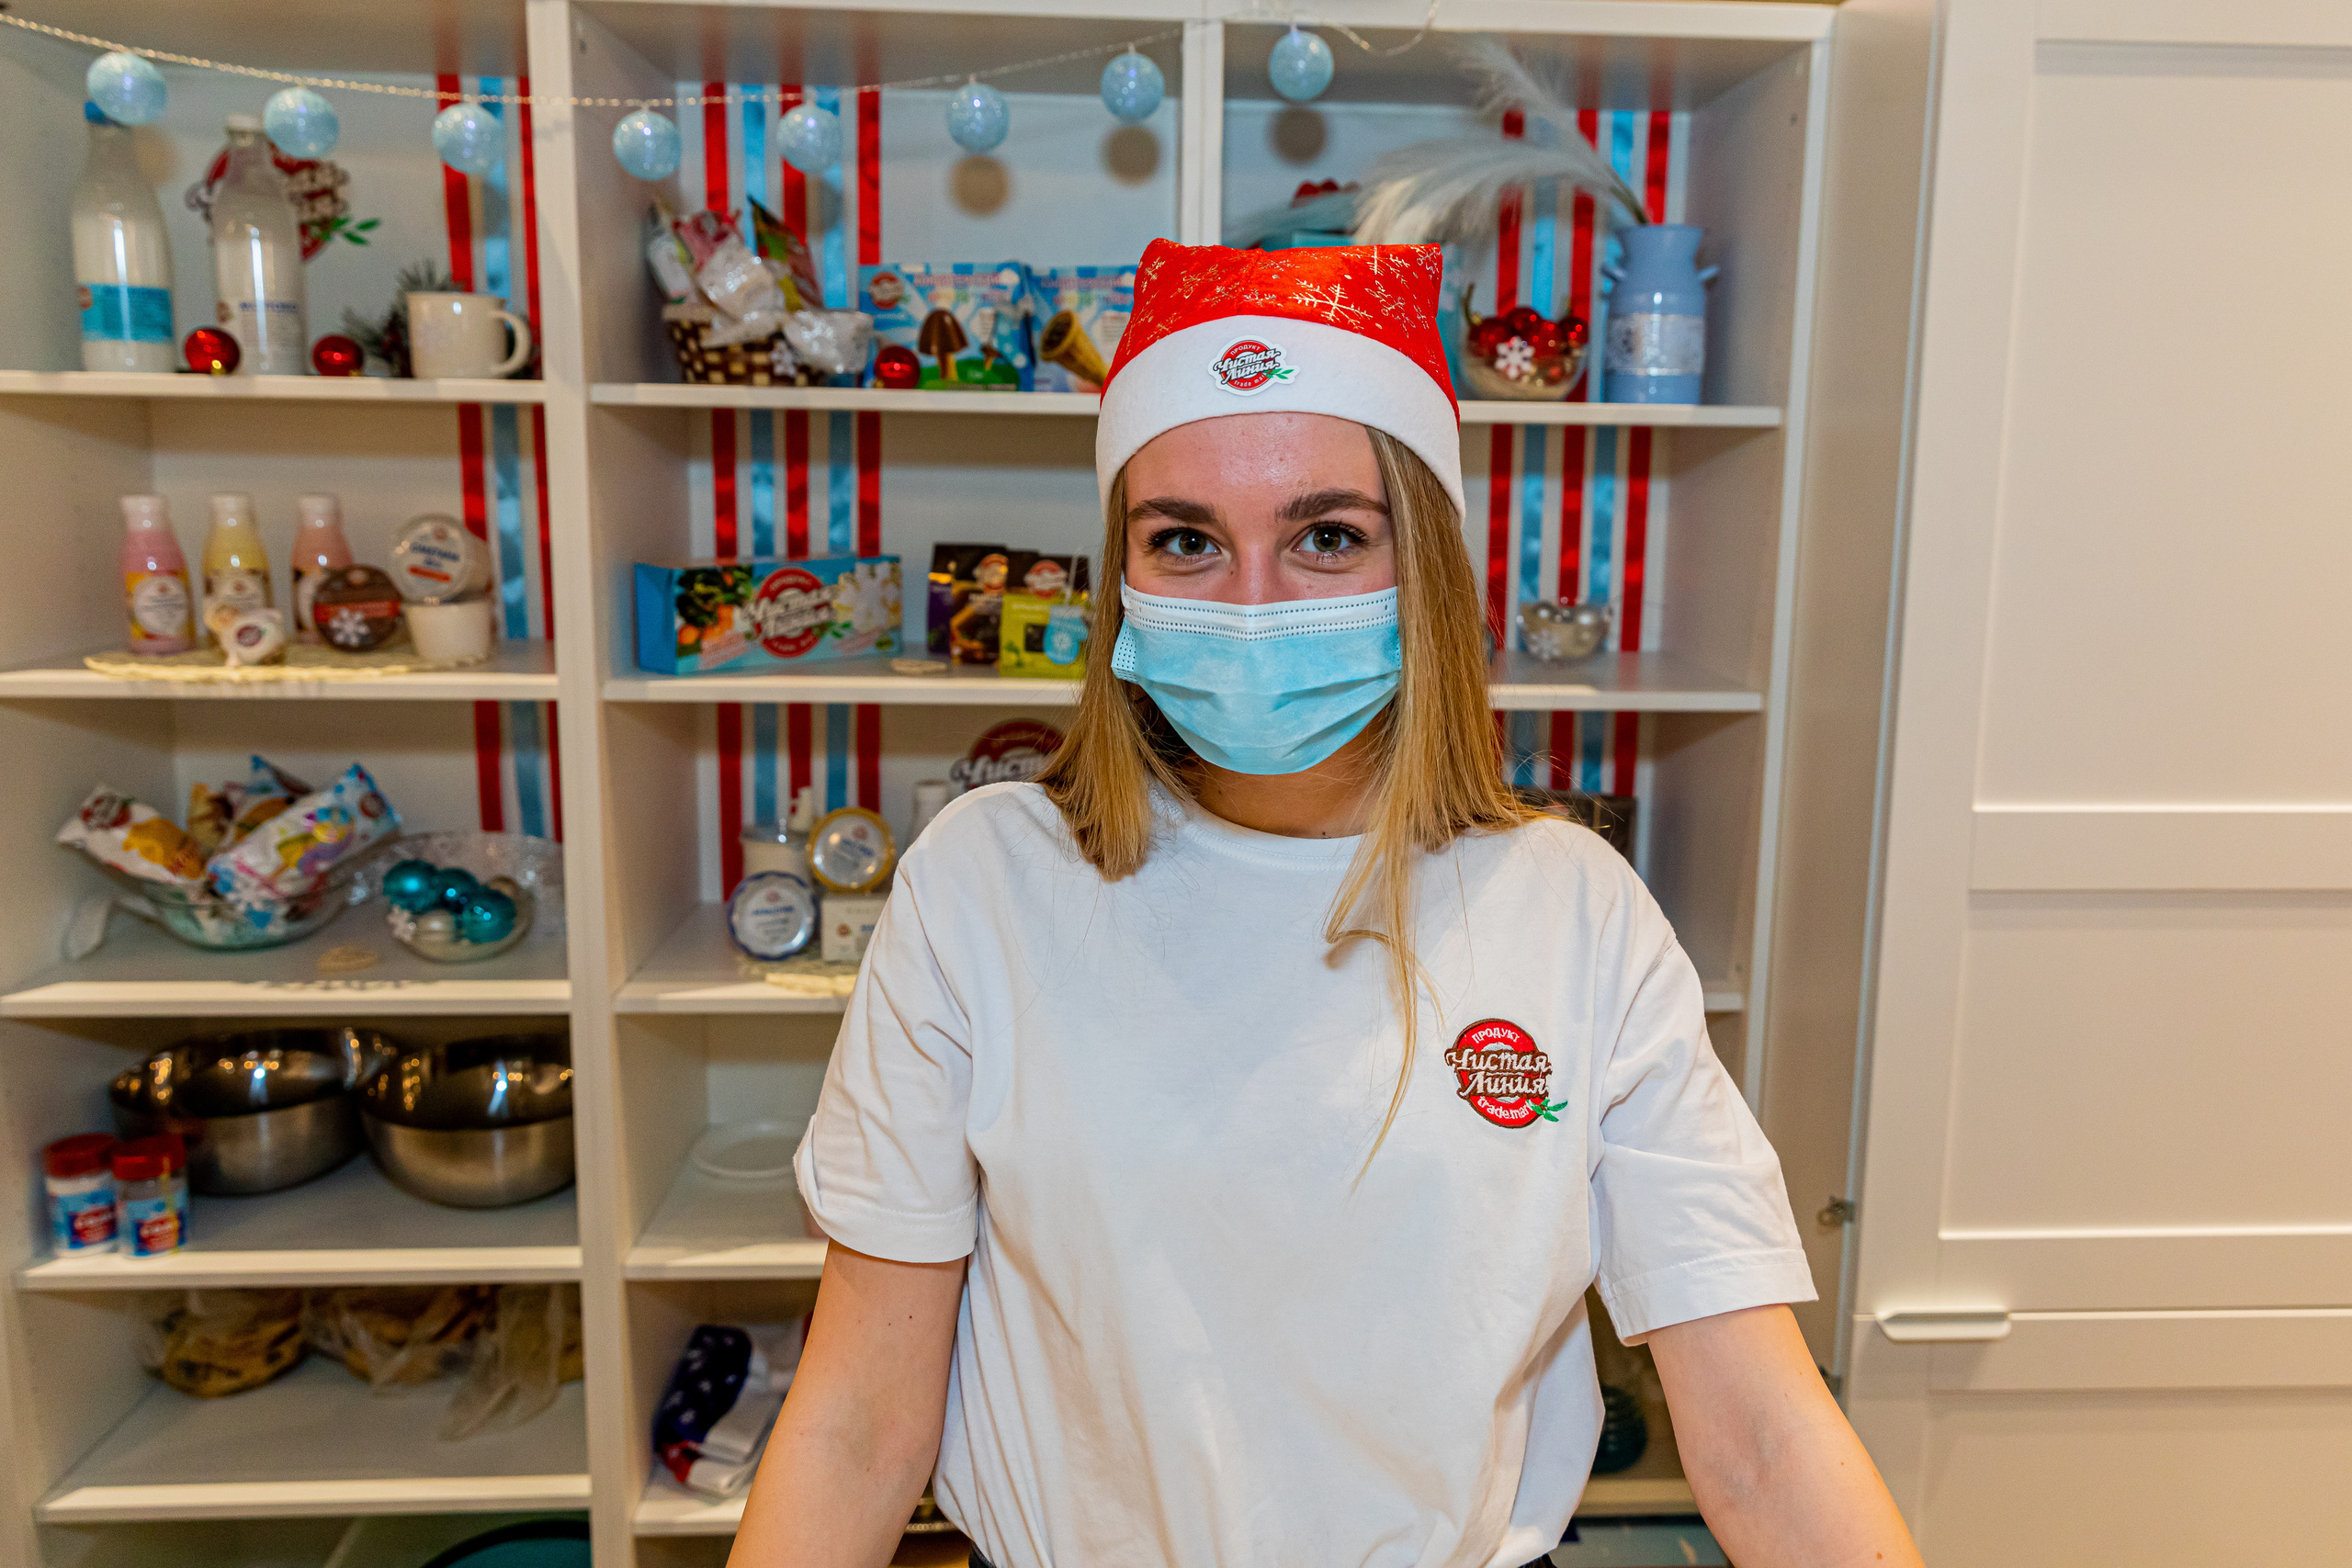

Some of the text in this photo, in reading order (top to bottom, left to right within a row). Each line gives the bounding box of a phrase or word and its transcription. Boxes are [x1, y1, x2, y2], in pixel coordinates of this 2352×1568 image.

[1213, 348, 1281, 374] Чистая
[1230, 344, 1261, 356] ПРОДУКТ
[1221, 358, 1281, 385] Линия
[1472, 1027, 1520, 1043] ПРОДУКТ
[1444, 1047, 1553, 1073] Чистая
[1458, 1069, 1552, 1097] Линия
